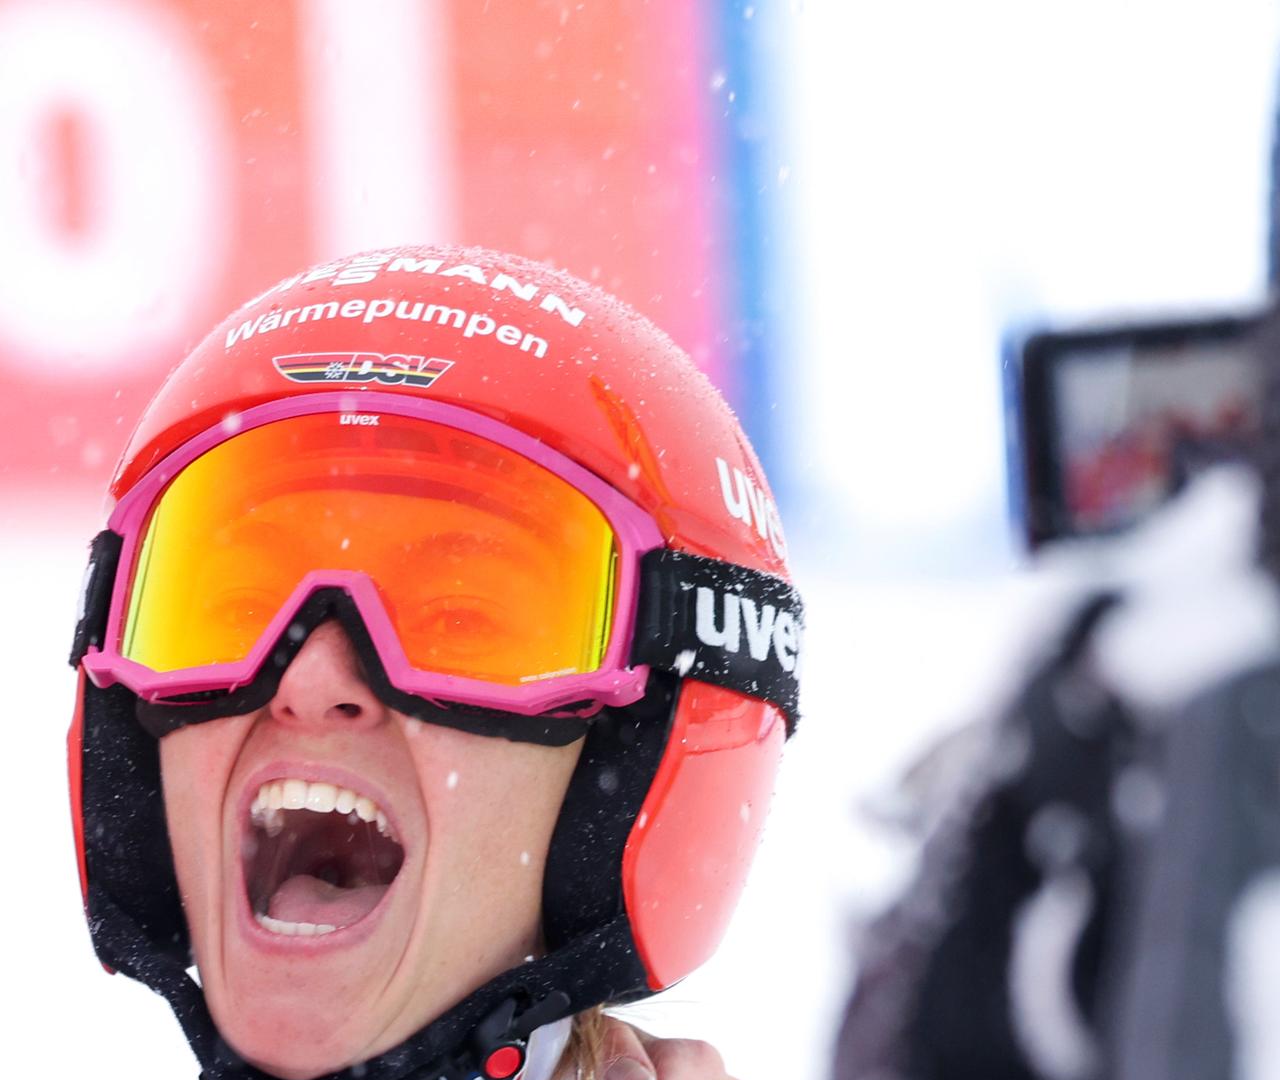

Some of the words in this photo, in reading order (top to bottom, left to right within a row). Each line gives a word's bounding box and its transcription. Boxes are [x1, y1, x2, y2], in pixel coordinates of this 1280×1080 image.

[224, 298, 549, 359] Wärmepumpen
[351, 352, 455, 389] DSV
[340, 413, 380, 427] uvex
